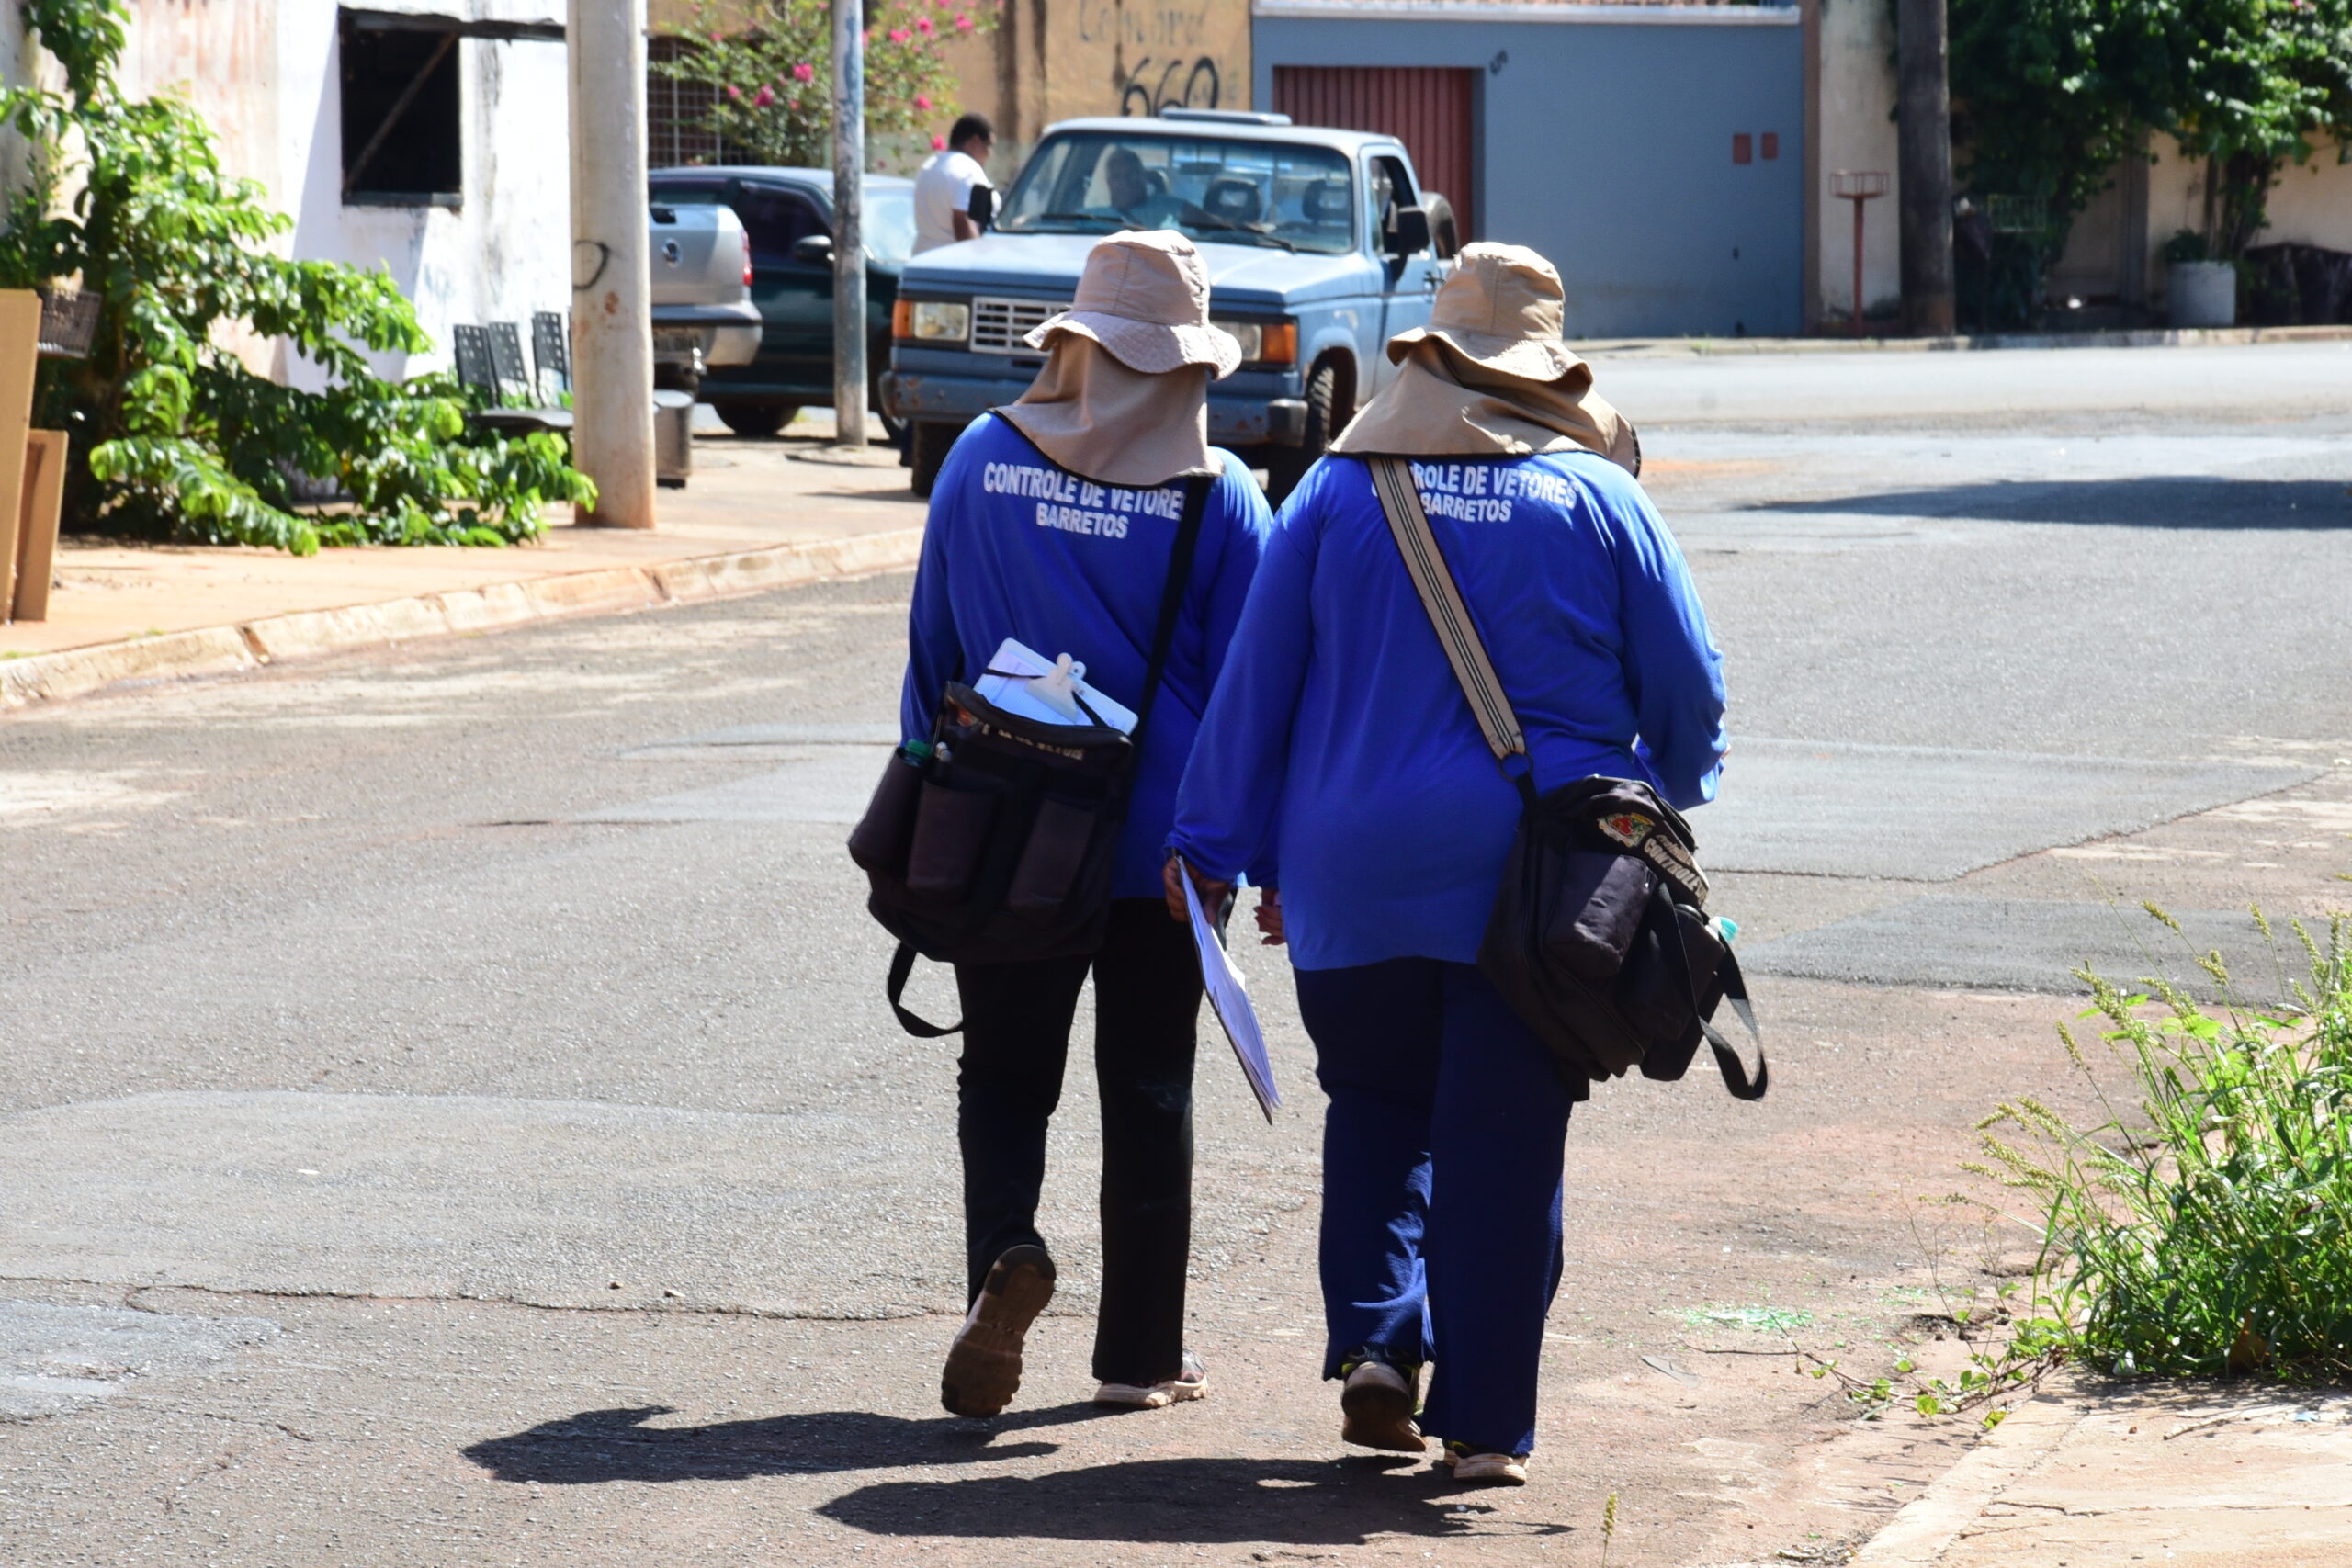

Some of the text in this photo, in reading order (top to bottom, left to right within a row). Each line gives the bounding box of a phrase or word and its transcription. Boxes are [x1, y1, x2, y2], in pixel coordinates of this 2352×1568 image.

[984, 463, 1184, 521] CONTROLE DE VETORE
[1420, 492, 1512, 522] BARRETOS
[1463, 465, 1488, 495] DE
[1493, 468, 1578, 509] VETORES
[1036, 502, 1129, 539] BARRETOS
